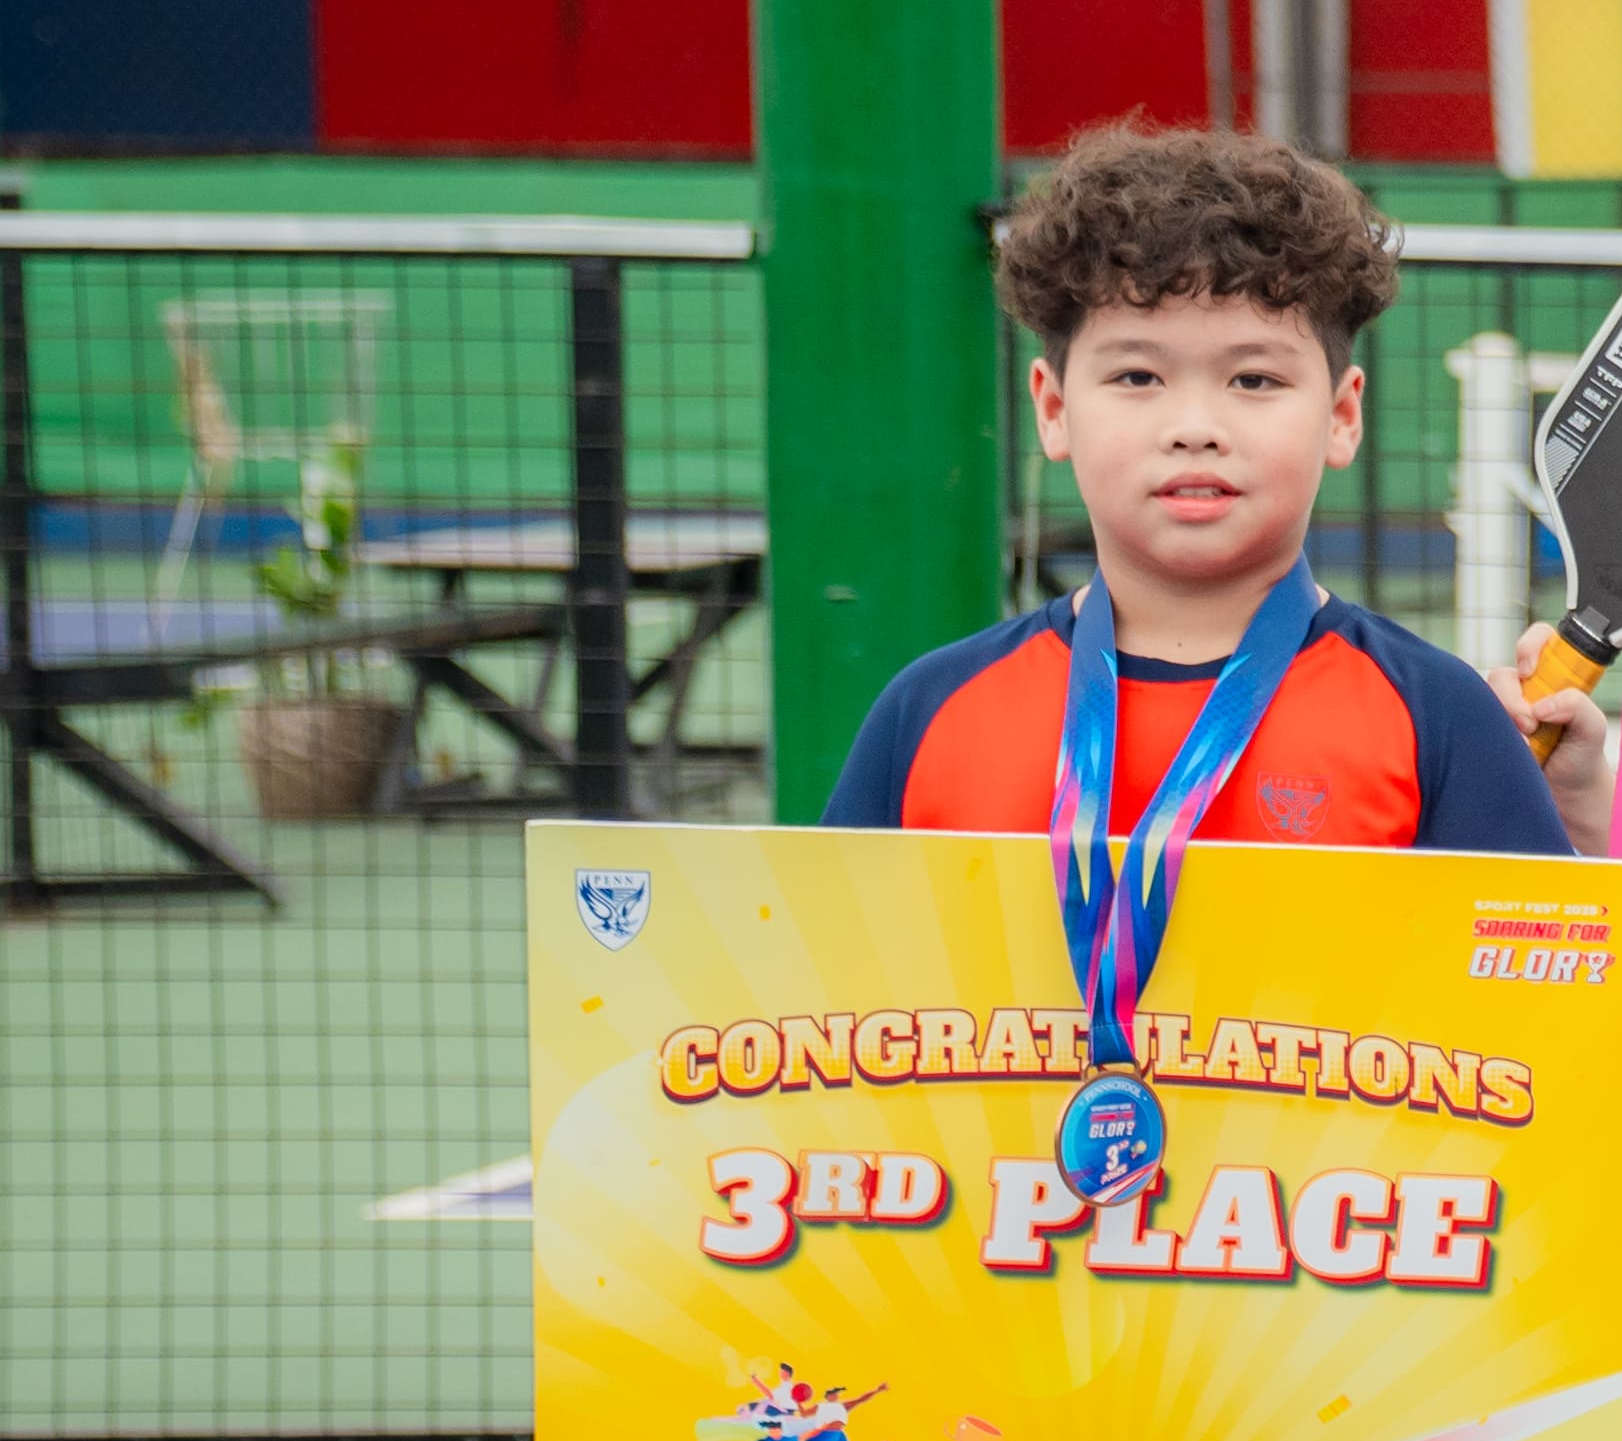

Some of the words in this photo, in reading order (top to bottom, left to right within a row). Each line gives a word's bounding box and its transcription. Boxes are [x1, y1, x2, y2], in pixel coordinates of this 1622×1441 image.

[1473, 919, 1564, 941] SOARING
[1567, 922, 1611, 943] FOR
[699, 1146, 947, 1266] 3RD
[979, 1155, 1499, 1291] PLACE
